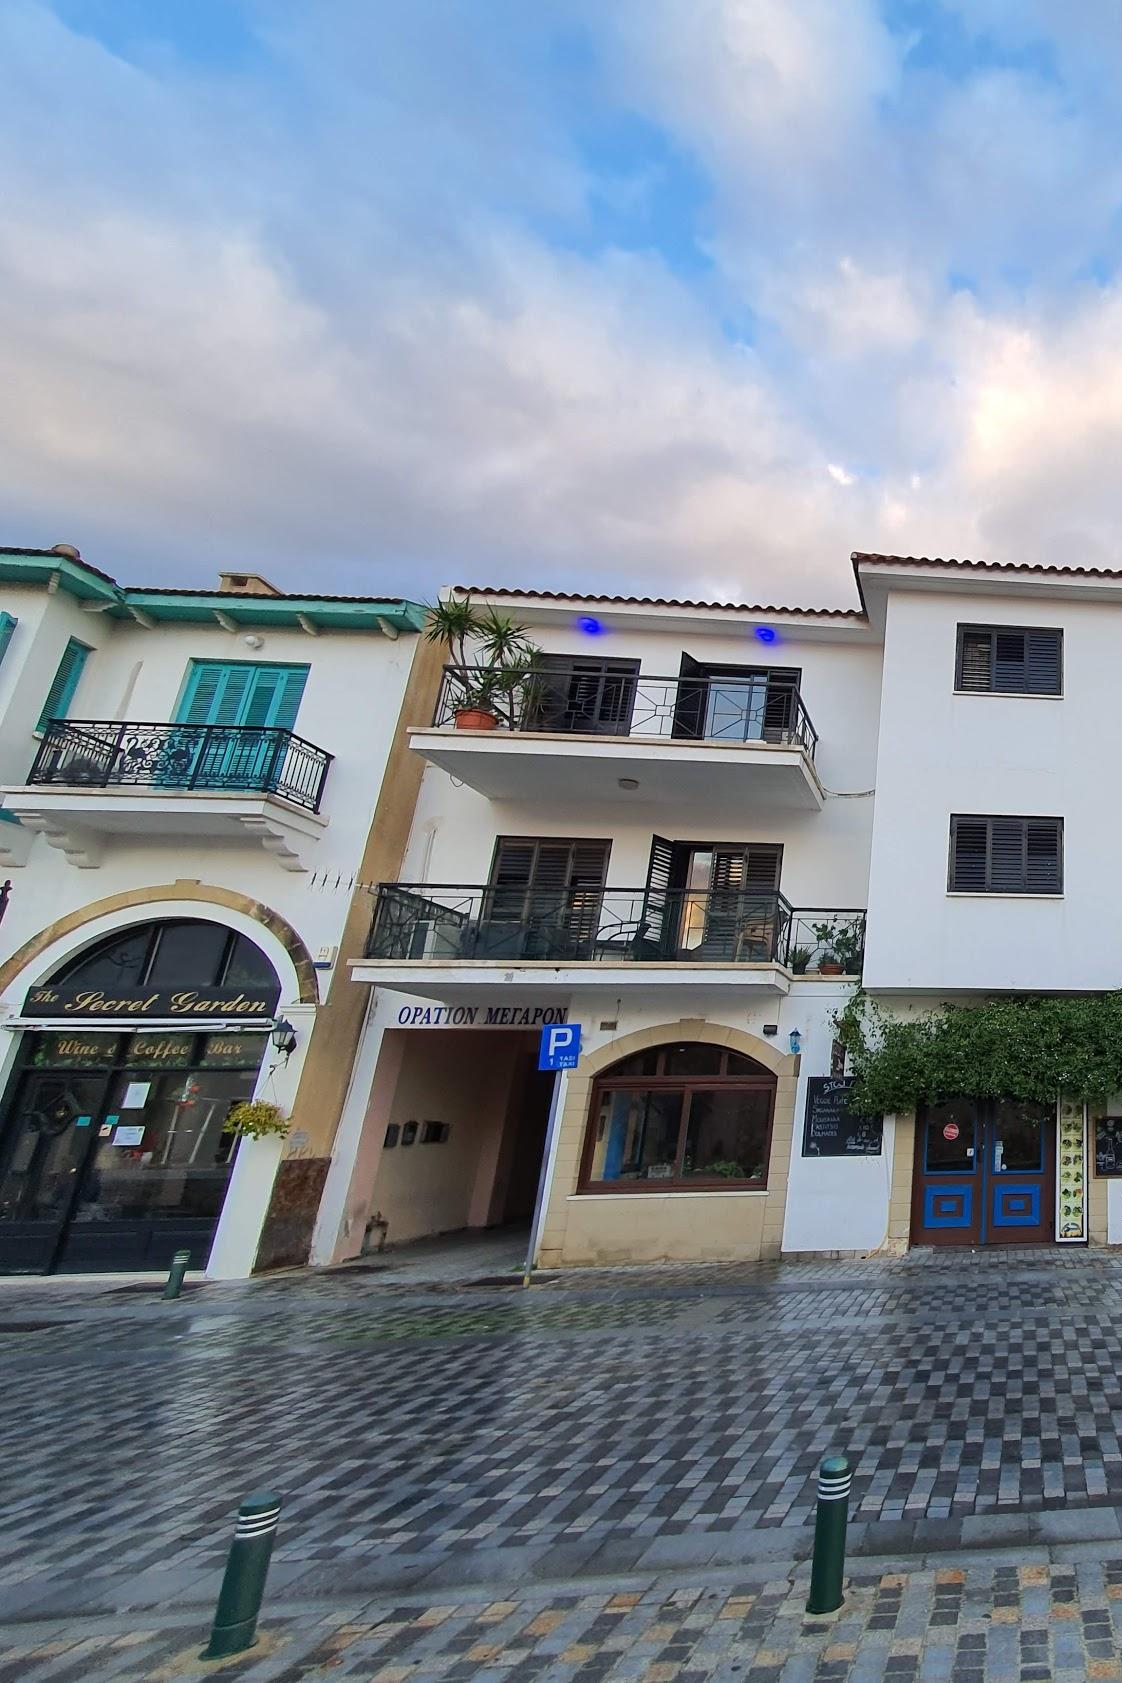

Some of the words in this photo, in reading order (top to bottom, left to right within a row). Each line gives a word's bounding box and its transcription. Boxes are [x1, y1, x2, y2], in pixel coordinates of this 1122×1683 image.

[31, 991, 59, 1003] The
[65, 991, 160, 1012] Secret
[170, 991, 267, 1013] Garden
[57, 1040, 99, 1055] Wine
[132, 1040, 190, 1058] Coffee
[207, 1041, 242, 1055] Bar
[549, 1028, 573, 1056] P
